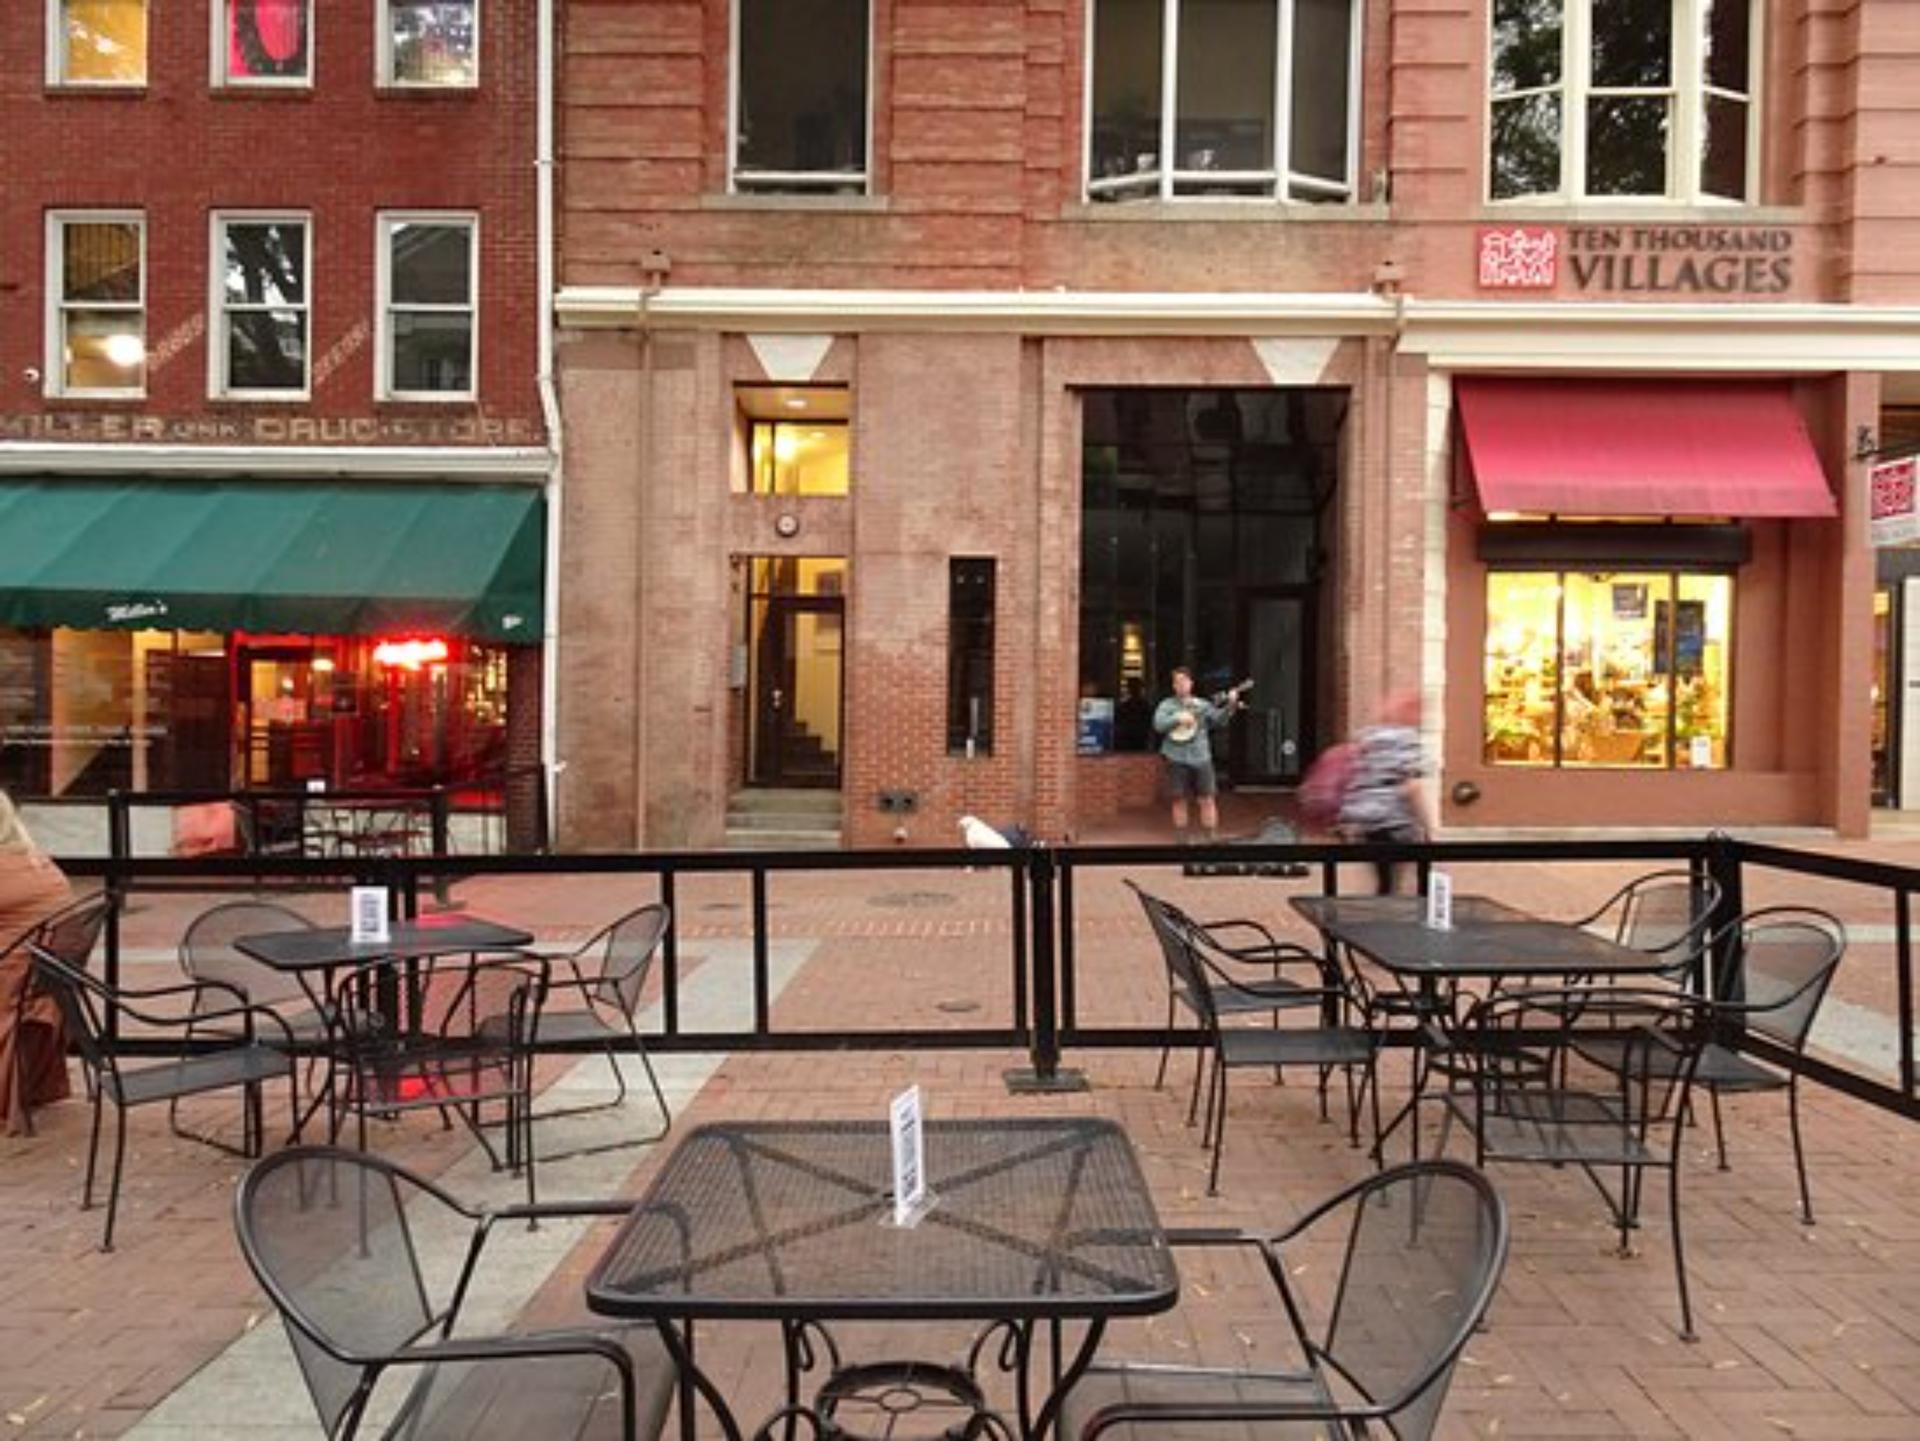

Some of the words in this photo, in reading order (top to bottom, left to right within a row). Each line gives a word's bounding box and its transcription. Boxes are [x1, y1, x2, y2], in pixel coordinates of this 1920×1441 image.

[1567, 228, 1620, 251] TEN
[1632, 229, 1793, 253] THOUSAND
[1568, 254, 1793, 293] VILLAGES
